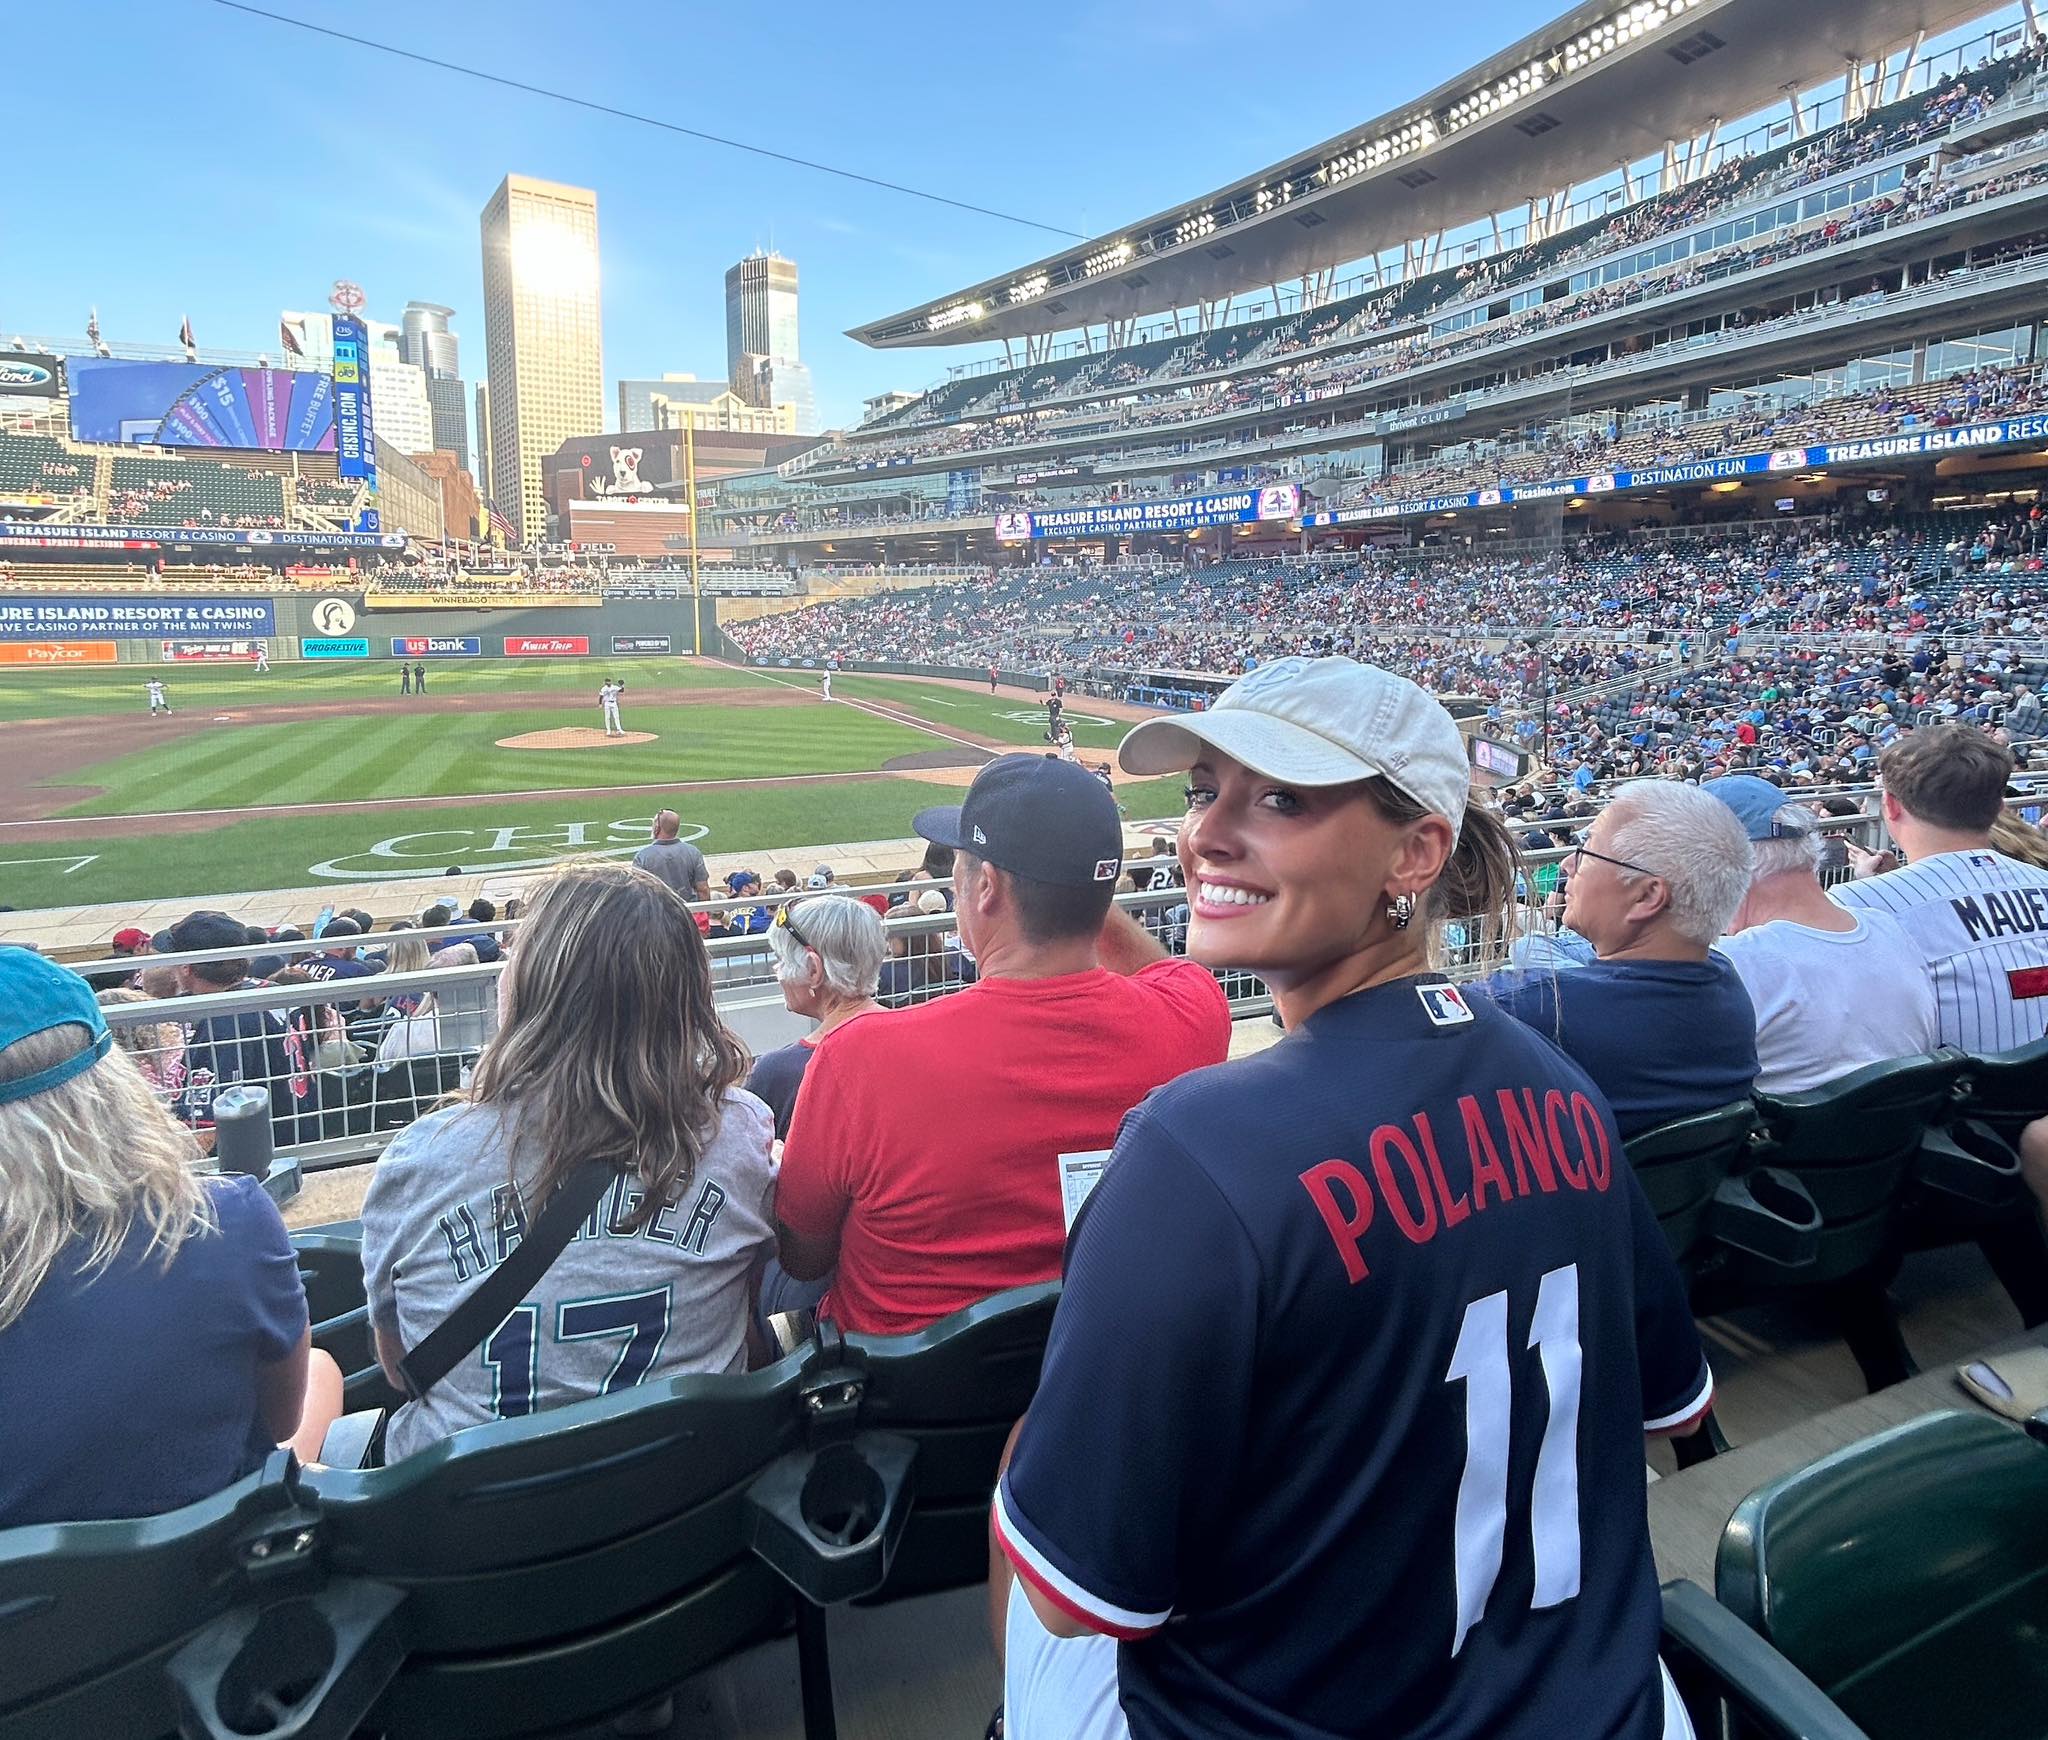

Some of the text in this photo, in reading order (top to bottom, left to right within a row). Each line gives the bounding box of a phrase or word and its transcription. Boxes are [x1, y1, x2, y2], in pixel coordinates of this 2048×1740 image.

[0, 366, 35, 383] ord
[210, 377, 236, 406] $15
[300, 374, 331, 437] FREE BUFFET
[1421, 411, 1449, 424] CLUB
[340, 392, 359, 458] CHSINC.COM
[1827, 437, 1921, 462] TREASURE
[1925, 426, 2001, 450] ISLAND
[1631, 460, 1746, 486] DESTINATION FUN
[1034, 511, 1093, 527] TREASURE
[1096, 507, 1142, 522] ISLAND
[1145, 502, 1193, 519] RESORT
[1195, 501, 1203, 514] &
[1206, 495, 1251, 512] CASINO
[1337, 496, 1469, 522] TREASURE ISLAND RESORT & CASINO
[6, 526, 235, 541] TREASURE ISLAND RESORT & CASINO
[1044, 512, 1239, 536] EXCLUSIVE CASINO PARTNER OF THE MN TWINS
[283, 534, 375, 545] DESTINATION FUN
[580, 543, 616, 552] FIELD
[431, 596, 488, 604] WINNEBAGO
[26, 622, 78, 631] CASINO
[82, 622, 139, 631] PARTNER
[143, 622, 159, 631] OF
[163, 622, 186, 630] THE
[190, 622, 209, 630] MN
[213, 621, 252, 630] TWINS
[38, 607, 109, 620] ISLAND
[112, 607, 183, 620] RESORT
[186, 608, 199, 619] &
[201, 607, 266, 619] CASINO
[27, 648, 88, 661] Paycor
[304, 643, 366, 652] PROGRESSIVE
[1950, 887, 2048, 942] MAUE
[1298, 1087, 1611, 1284] POLANCO
[481, 1280, 674, 1420] 17
[1444, 1262, 1583, 1659] 11
